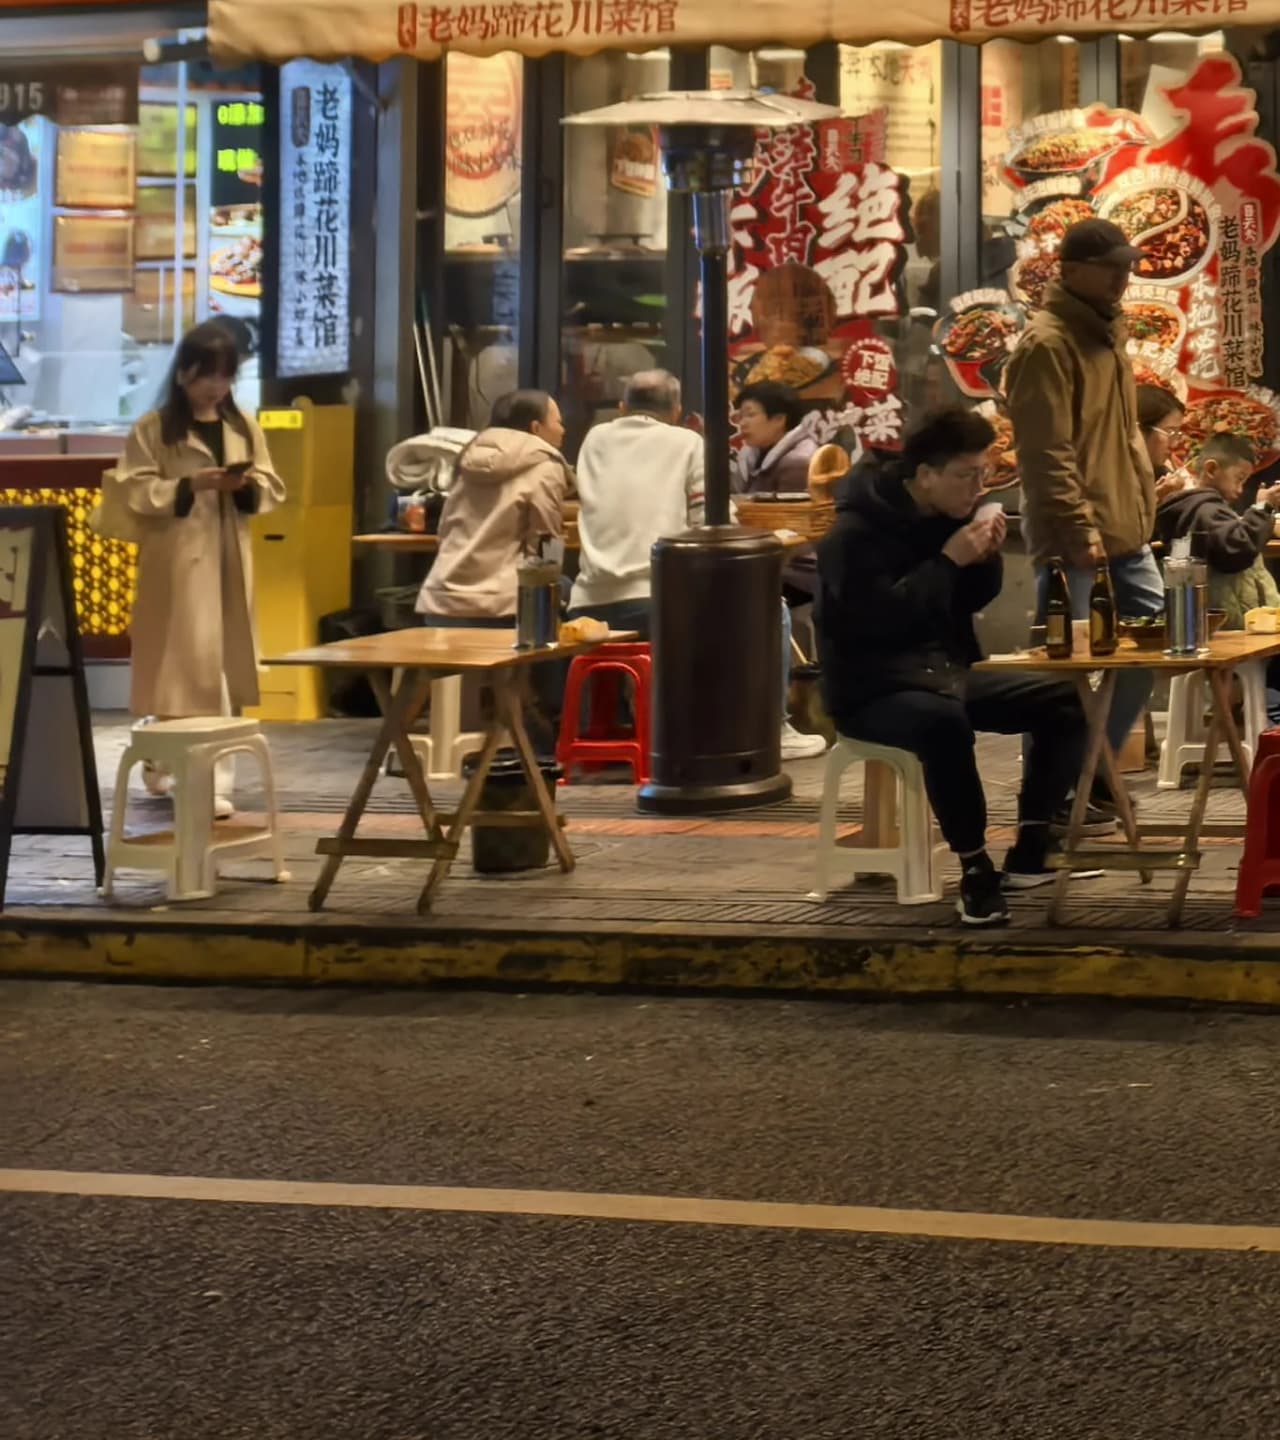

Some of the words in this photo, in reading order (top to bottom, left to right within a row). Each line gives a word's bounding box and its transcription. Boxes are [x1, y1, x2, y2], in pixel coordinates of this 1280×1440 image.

[313, 83, 340, 348] 老妈蹄花川菜馆
[815, 162, 905, 318] 绝配
[1218, 215, 1246, 388] 老妈蹄花川菜馆
